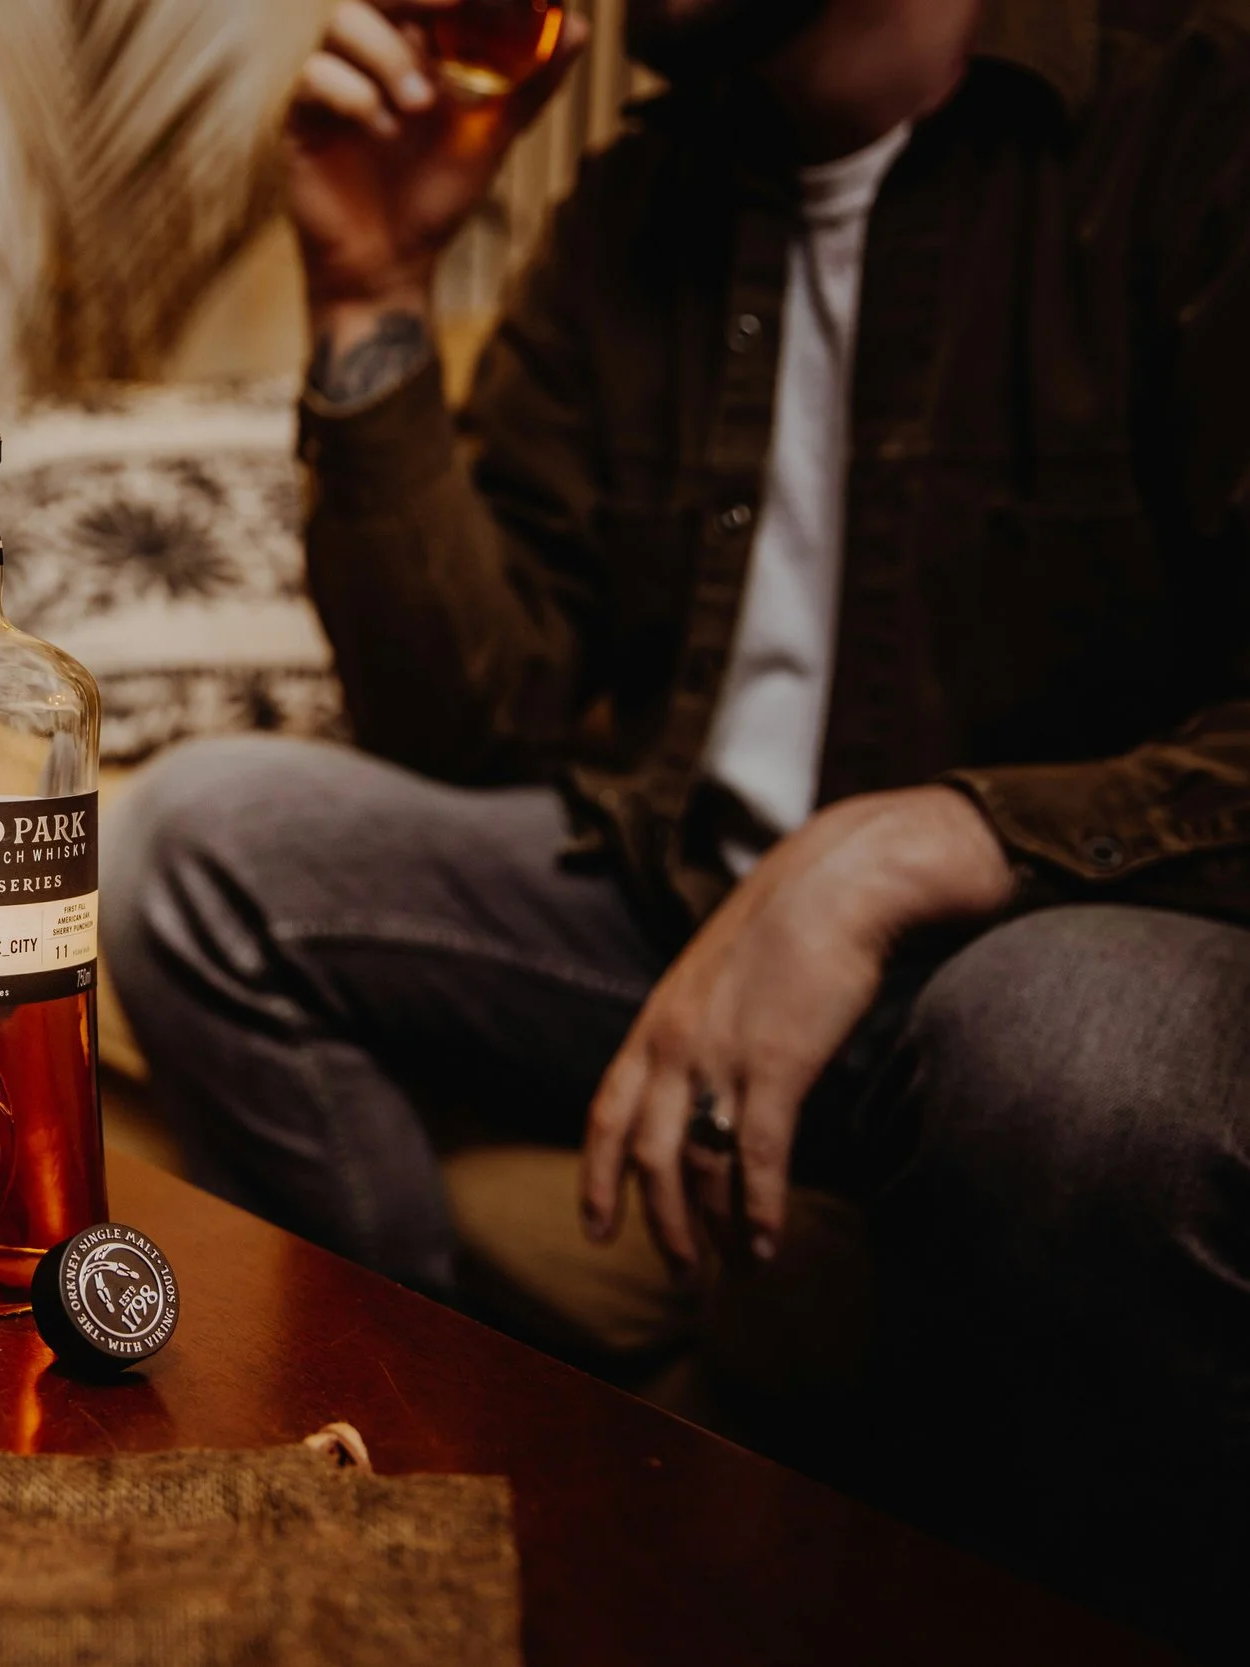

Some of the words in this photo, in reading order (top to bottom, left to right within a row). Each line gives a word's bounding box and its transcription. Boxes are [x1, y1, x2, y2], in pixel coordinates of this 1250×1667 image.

[13, 810, 86, 843] PARK
[32, 842, 86, 862] WHISKY
[58, 914, 82, 924] AMERICAN
[64, 905, 78, 914] FIRST
[53, 926, 72, 936] SHERRY
[55, 944, 68, 959] 11
[78, 1228, 121, 1252] SINGLE
[125, 1231, 160, 1260] MALT
[66, 1251, 81, 1310] ORKNEY
[160, 1265, 176, 1303] SOUL
[121, 1284, 158, 1333] 1798
[77, 1313, 99, 1340] THE
[145, 1307, 176, 1347] VIKING
[108, 1337, 143, 1353] WITH
